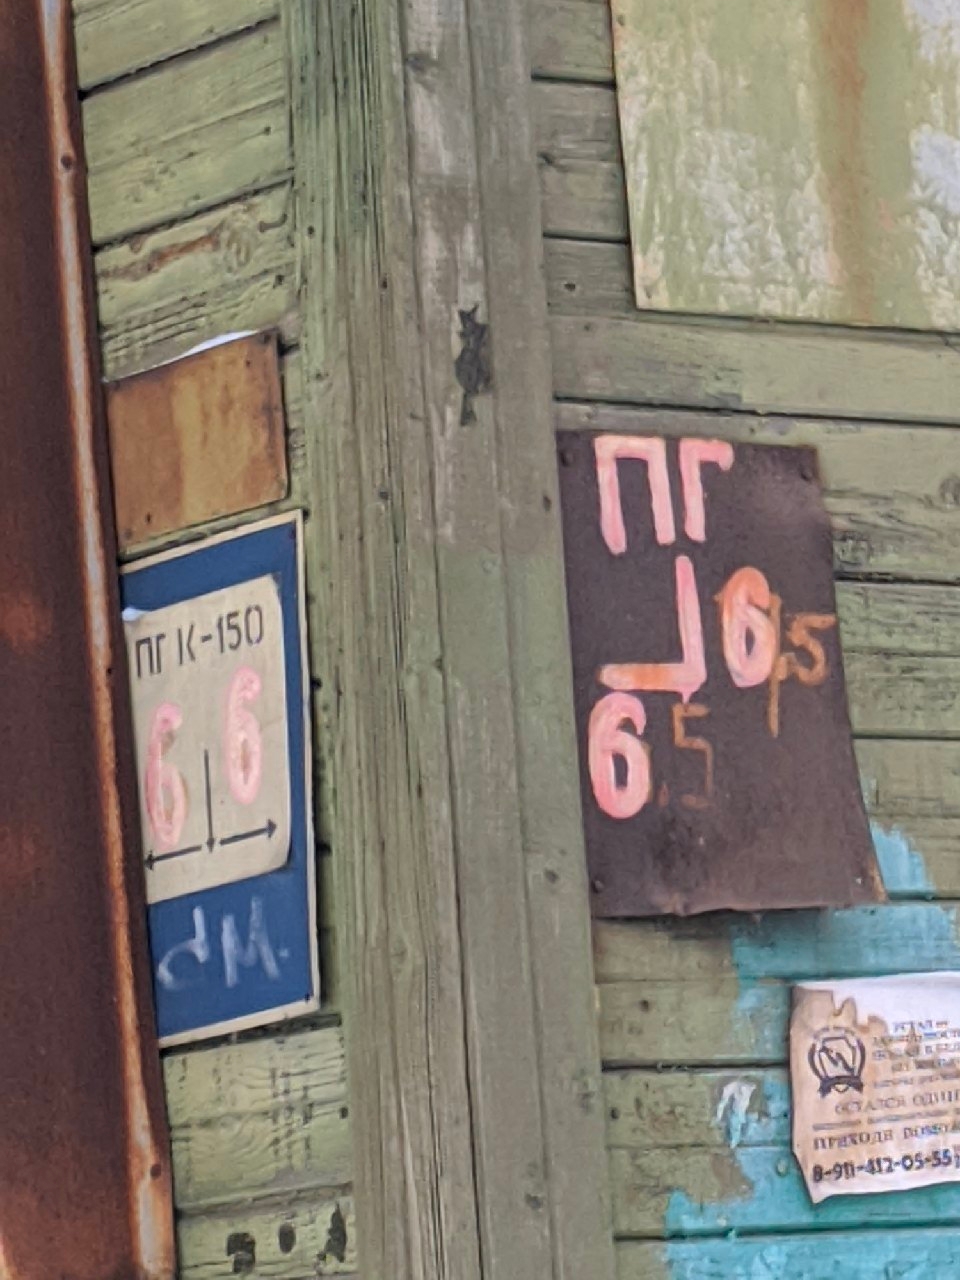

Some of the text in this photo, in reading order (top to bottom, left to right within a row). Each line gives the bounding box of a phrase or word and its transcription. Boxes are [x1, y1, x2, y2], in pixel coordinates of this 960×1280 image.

[594, 434, 734, 555] ПГ
[144, 700, 190, 852] 6
[222, 665, 263, 807] 6
